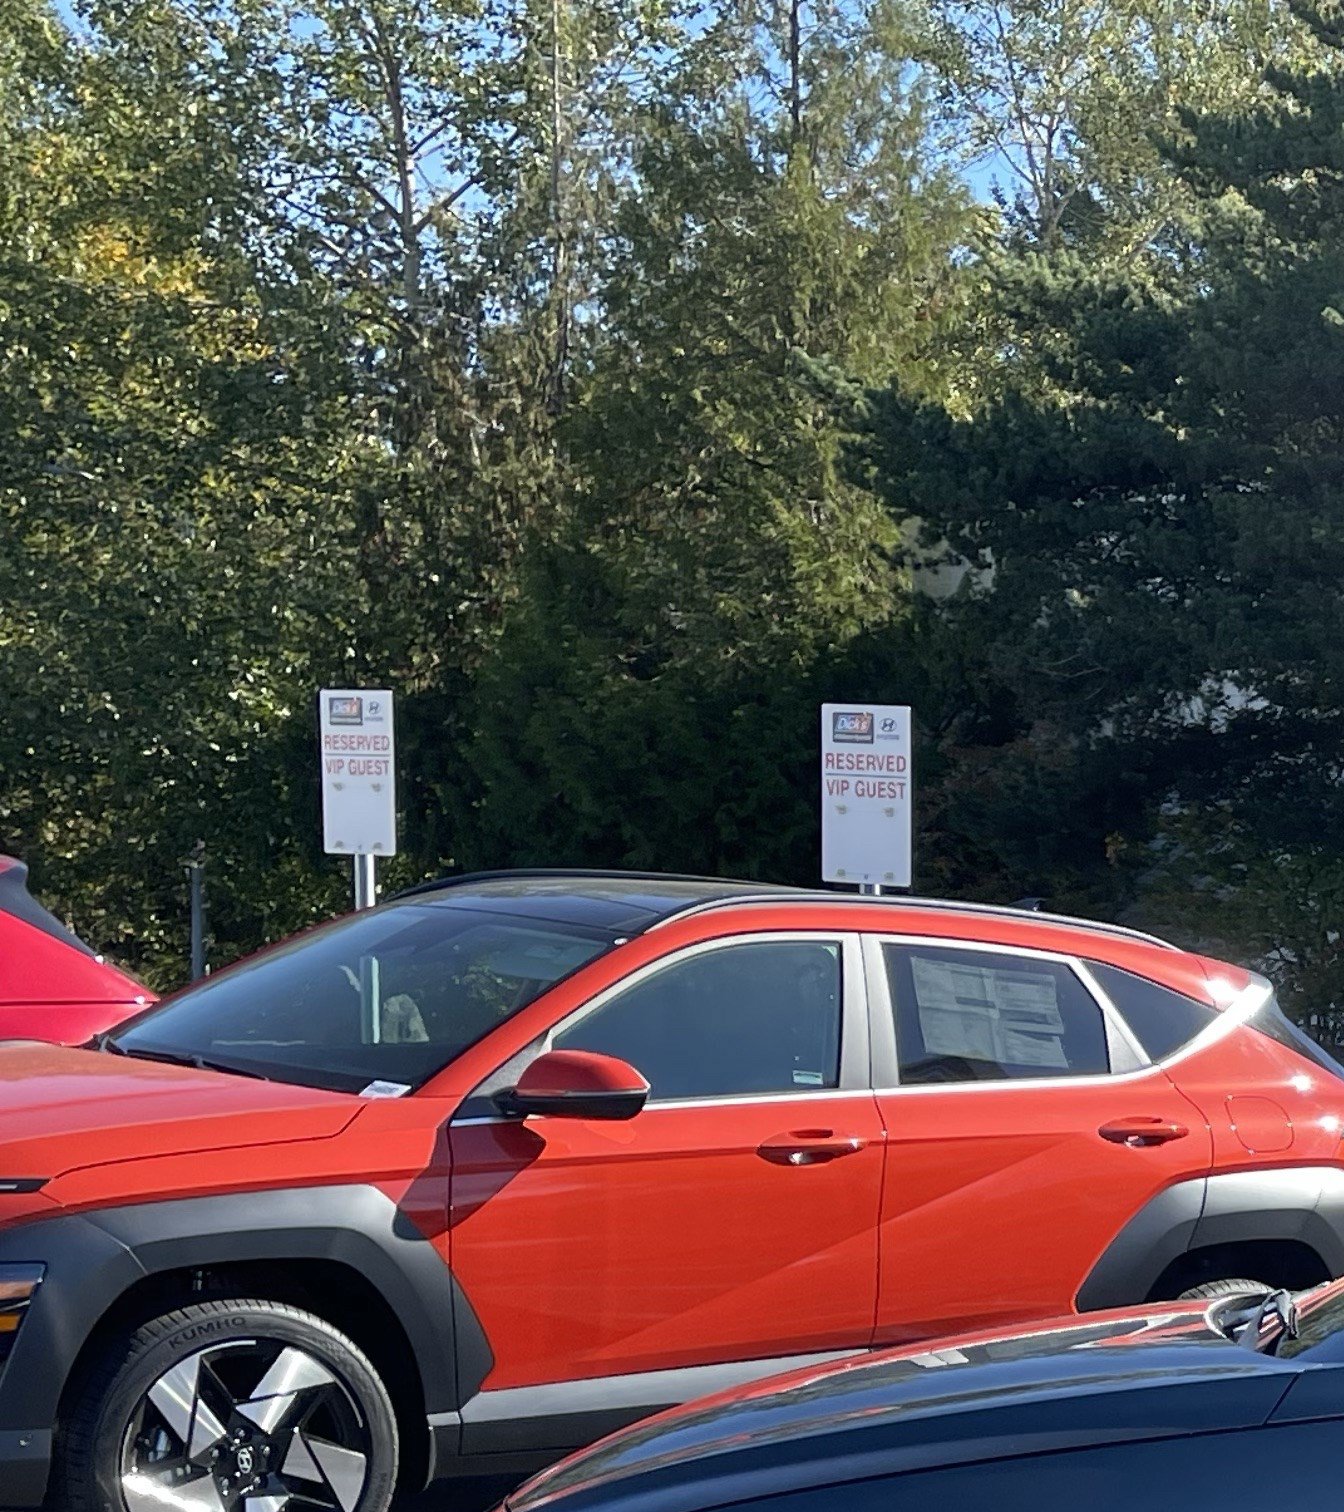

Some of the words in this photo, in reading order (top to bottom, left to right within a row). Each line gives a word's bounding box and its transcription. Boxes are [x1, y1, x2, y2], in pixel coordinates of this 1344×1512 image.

[323, 734, 390, 751] RESERVED
[325, 759, 345, 775] VIP
[349, 759, 390, 775] GUEST
[825, 752, 906, 773] RESERVED
[826, 779, 850, 796] VIP
[855, 780, 906, 800] GUEST
[168, 1316, 246, 1349] KUMHO
